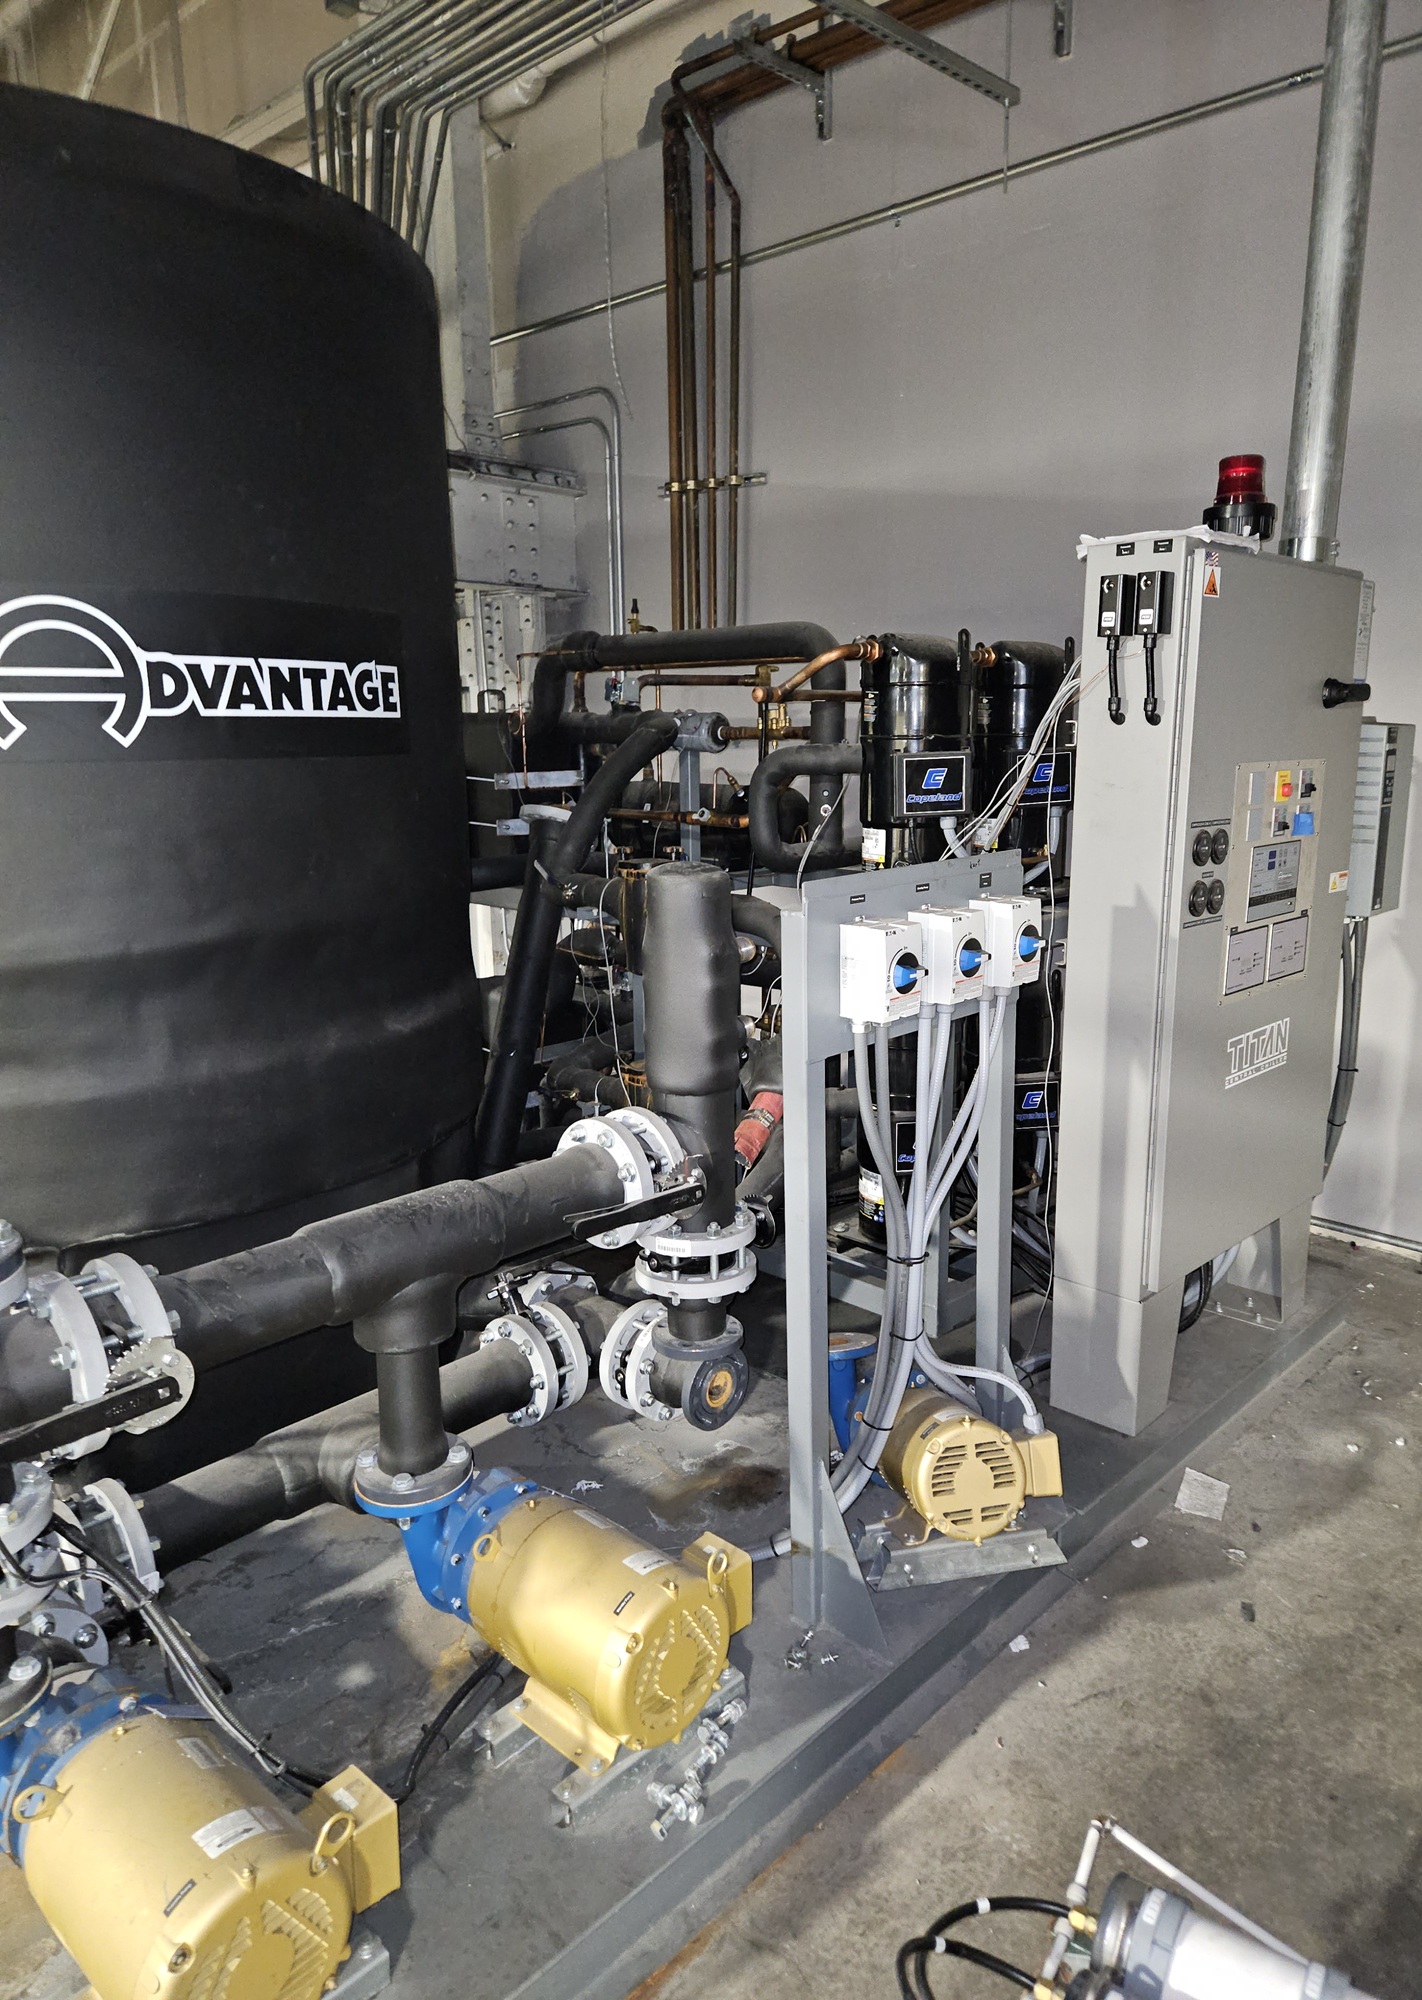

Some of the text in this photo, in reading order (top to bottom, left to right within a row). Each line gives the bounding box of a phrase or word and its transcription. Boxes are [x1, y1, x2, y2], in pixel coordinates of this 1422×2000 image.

[906, 791, 963, 804] Copeland
[1227, 1017, 1290, 1074] TITAN
[1225, 1055, 1288, 1086] CENTRAL CHILLER
